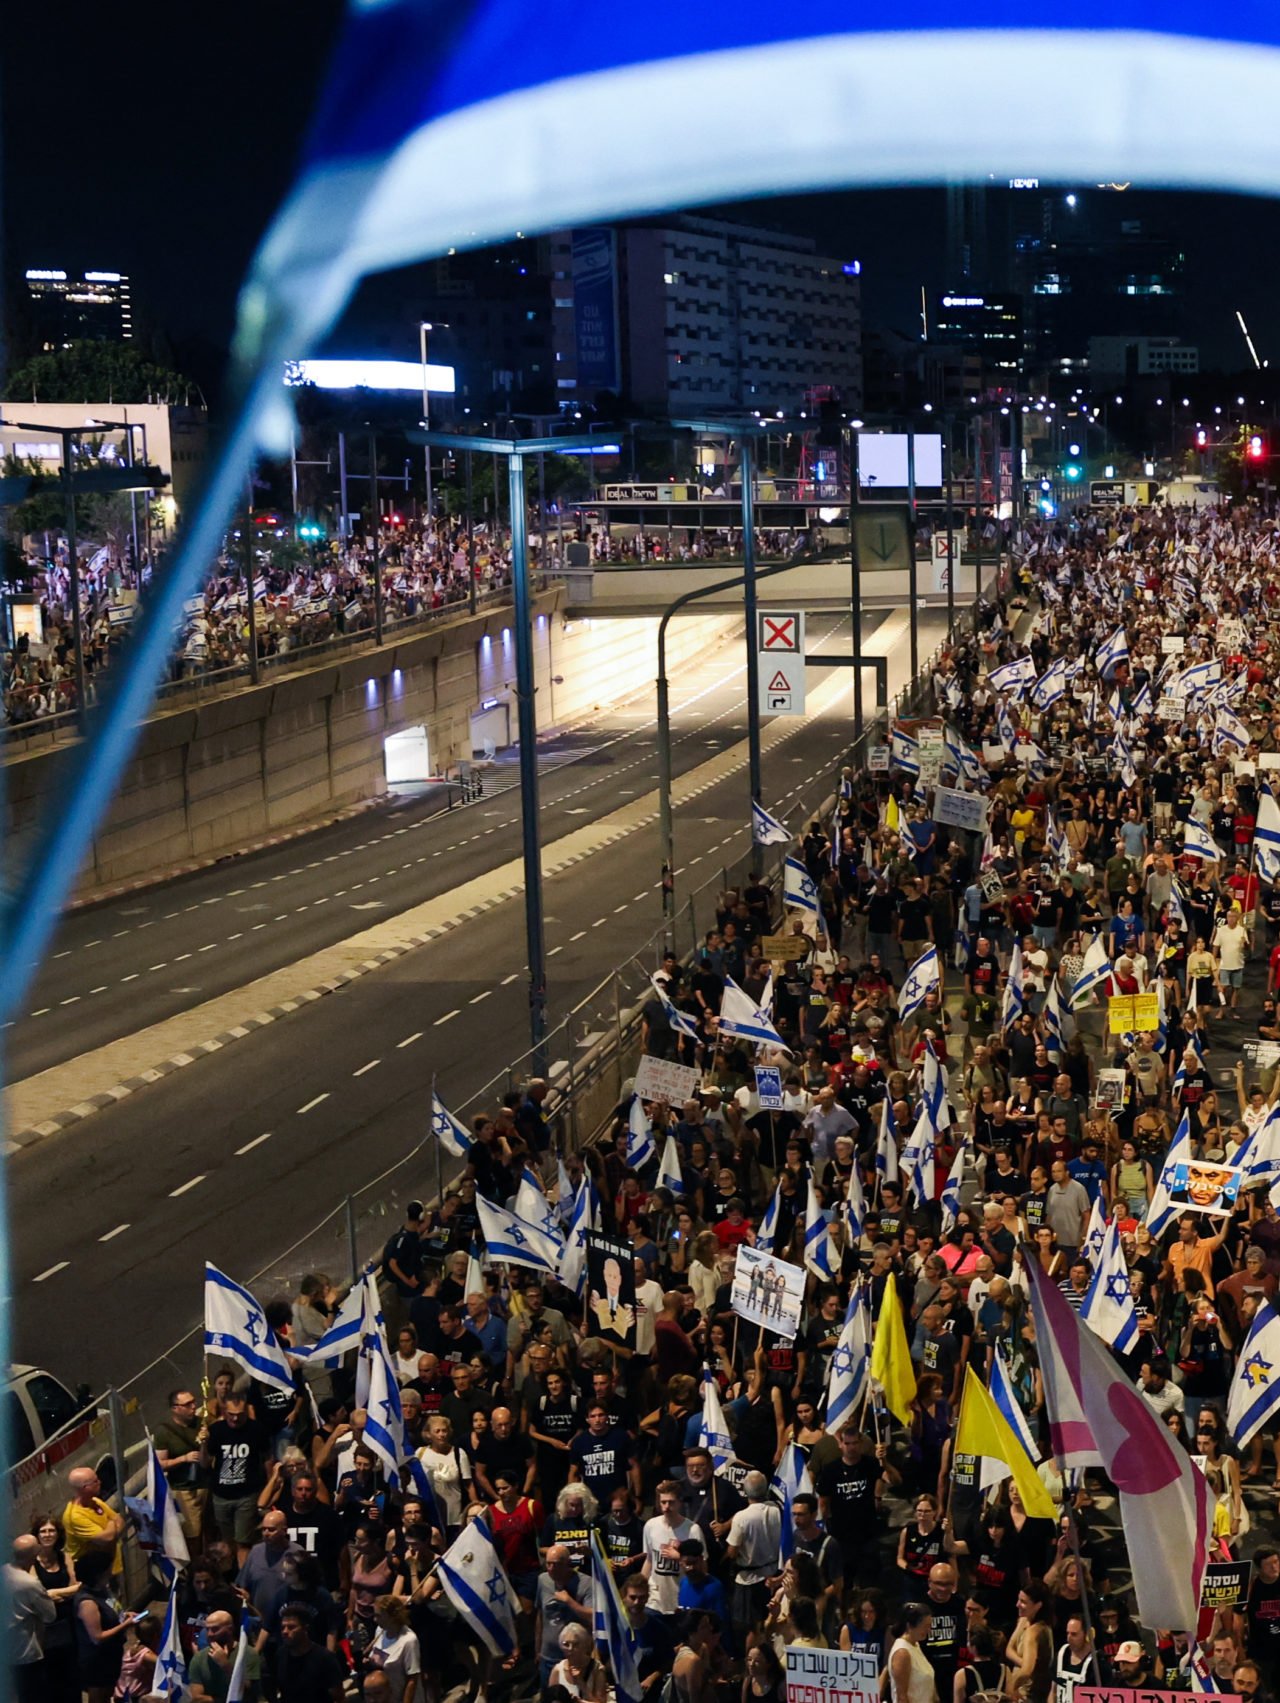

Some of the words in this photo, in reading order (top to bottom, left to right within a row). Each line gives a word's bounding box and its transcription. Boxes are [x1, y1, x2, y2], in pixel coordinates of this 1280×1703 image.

[608, 490, 629, 499] IDEAL
[620, 1247, 631, 1261] way
[221, 1444, 250, 1459] 7.10
[555, 1530, 588, 1541] מאבק
[1204, 1574, 1240, 1588] עסקה
[835, 1653, 876, 1679] כולנו
[820, 1675, 837, 1689] 62
